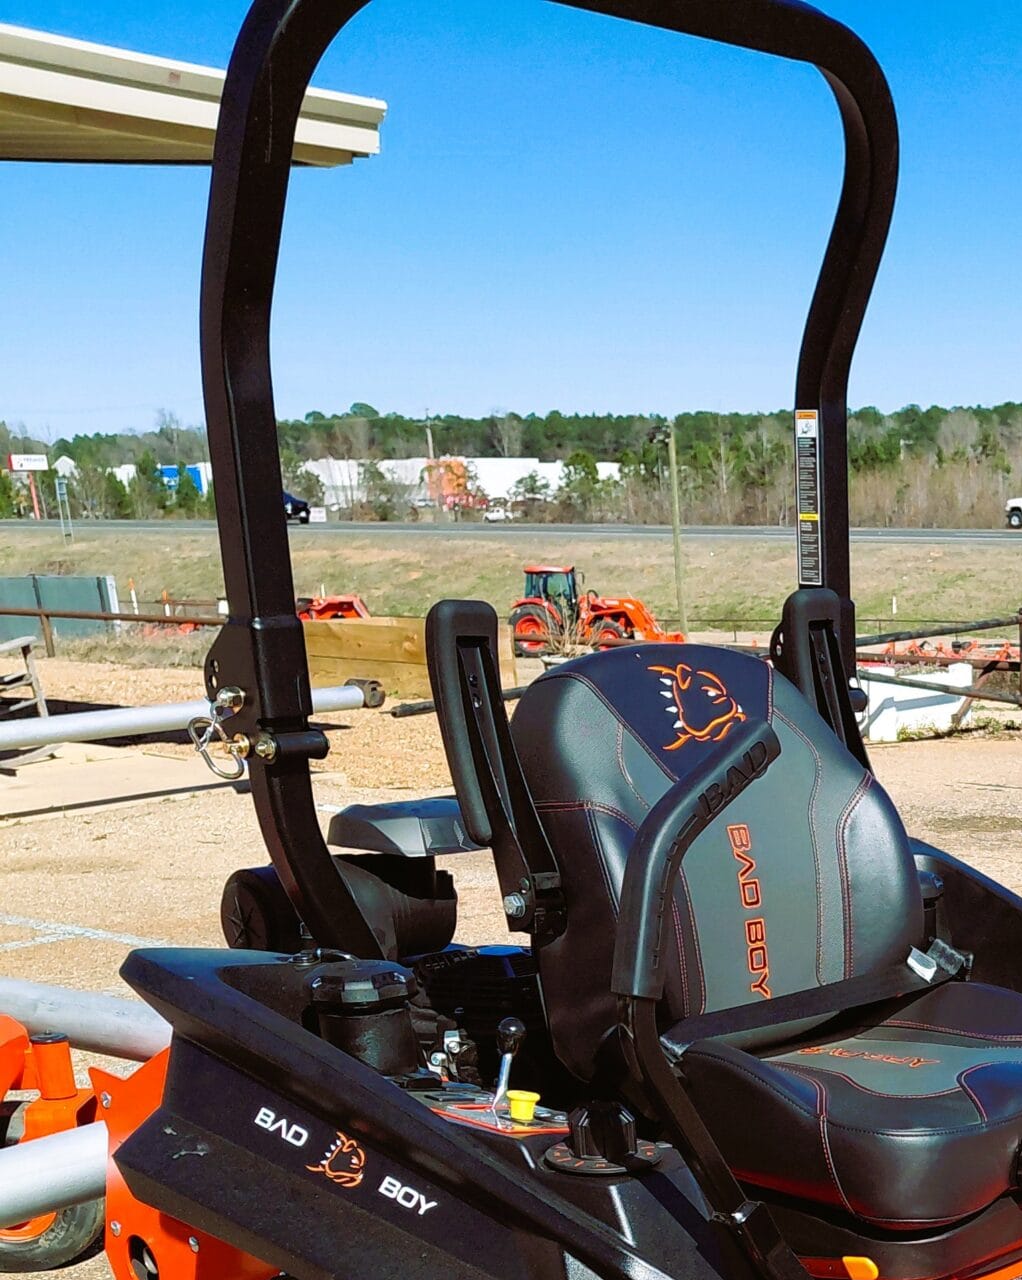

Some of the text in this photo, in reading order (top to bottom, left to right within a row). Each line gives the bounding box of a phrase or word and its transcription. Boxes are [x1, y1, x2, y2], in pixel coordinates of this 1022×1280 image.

[698, 741, 768, 820] BAD
[727, 824, 771, 1000] BAD BOY
[254, 1107, 437, 1215] BAD BOY
